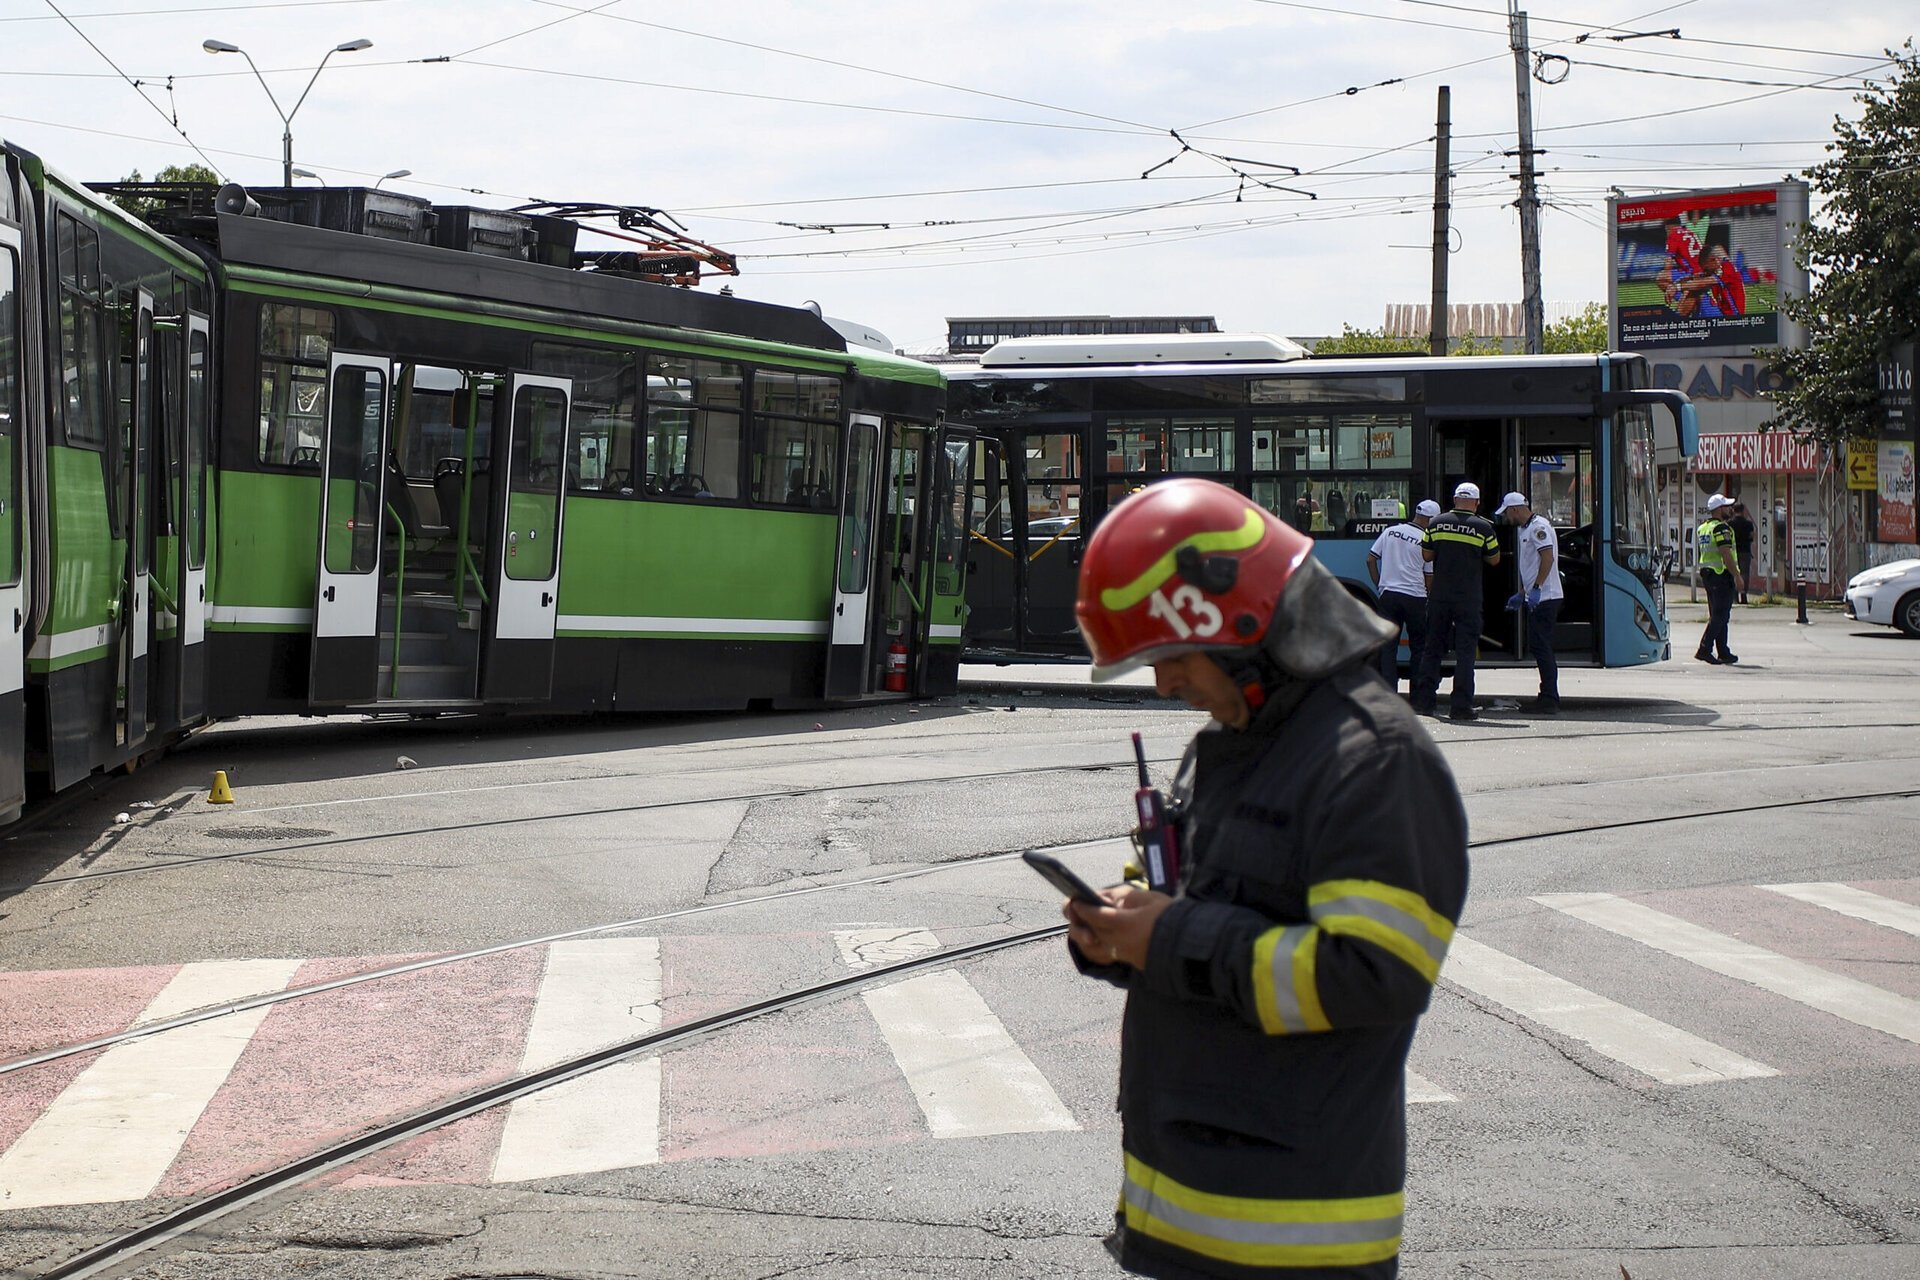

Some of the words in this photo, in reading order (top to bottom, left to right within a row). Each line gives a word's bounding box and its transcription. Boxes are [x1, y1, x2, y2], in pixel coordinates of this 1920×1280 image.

[1879, 361, 1912, 390] hiko
[1698, 436, 1737, 470] SERVICE
[1740, 435, 1761, 470] GSM
[1764, 435, 1771, 470] &
[1774, 433, 1817, 470] LAPTOP
[1356, 524, 1388, 533] KENT
[1436, 523, 1476, 536] POLITIA
[1148, 585, 1224, 640] 13
